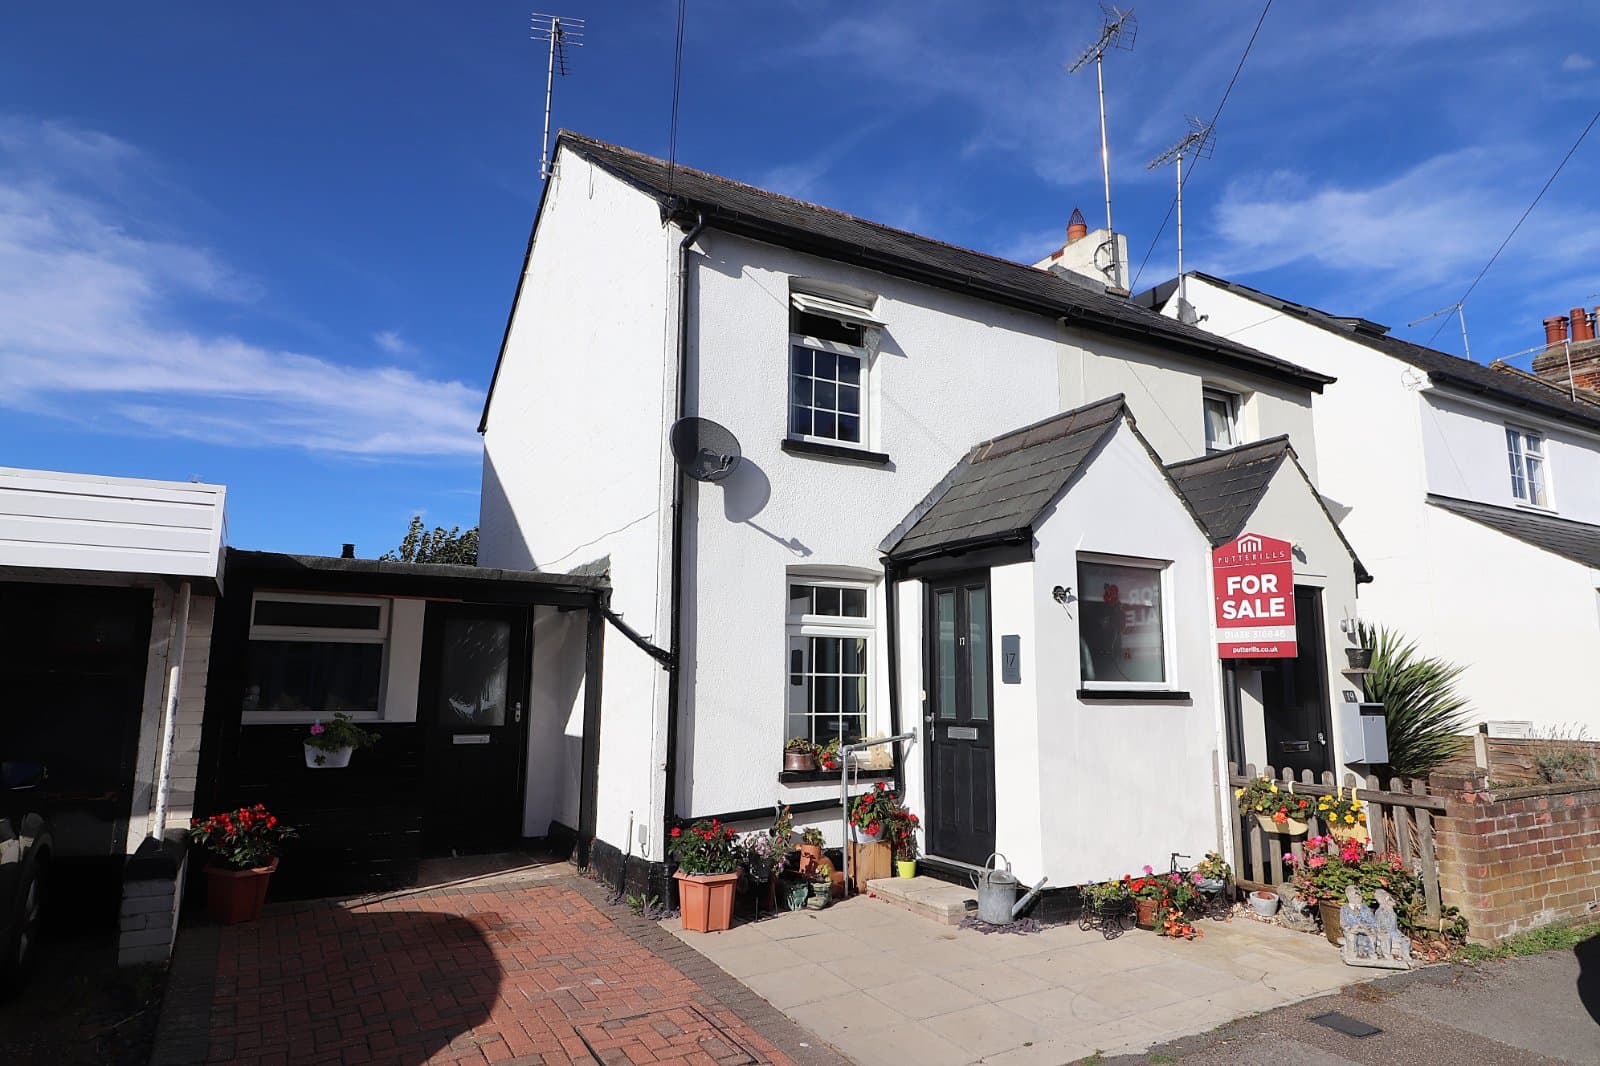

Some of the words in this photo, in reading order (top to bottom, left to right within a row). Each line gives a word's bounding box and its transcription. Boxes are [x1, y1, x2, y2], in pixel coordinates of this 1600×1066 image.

[1218, 551, 1285, 564] PUTTERILLS
[1226, 573, 1278, 596] FOR
[1222, 597, 1286, 620] SALE
[1005, 653, 1016, 667] 17
[1346, 690, 1355, 699] 19
